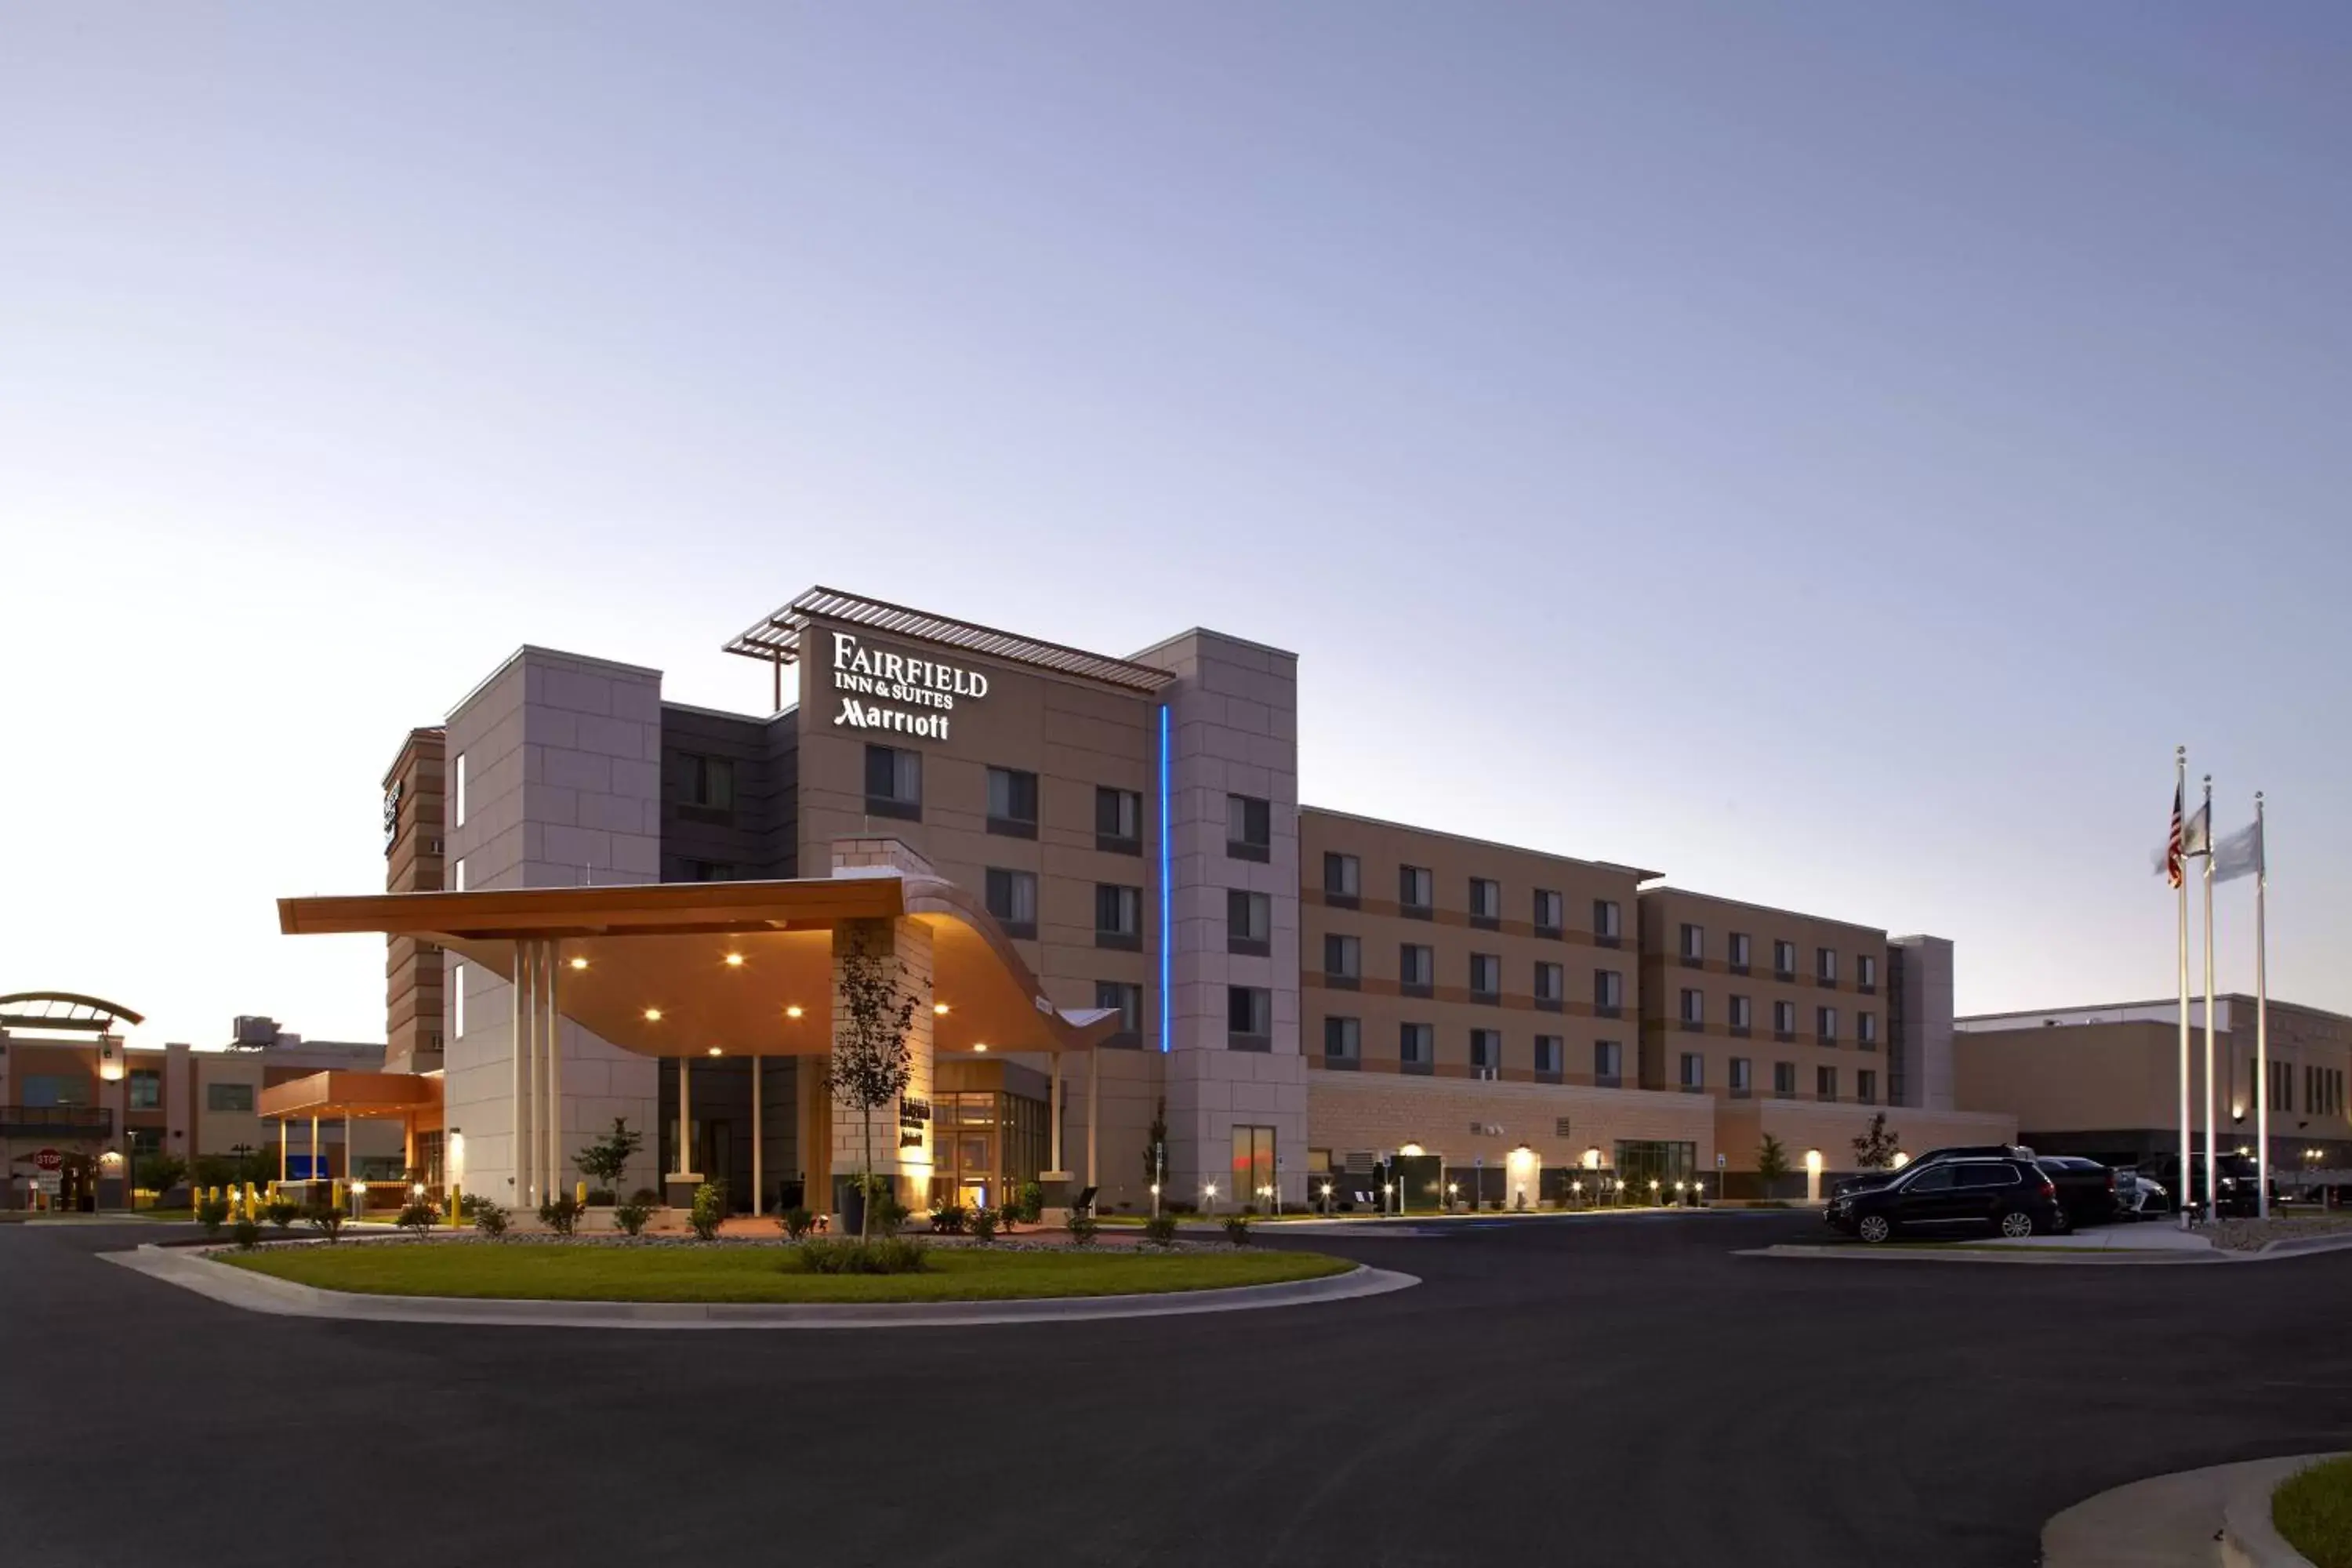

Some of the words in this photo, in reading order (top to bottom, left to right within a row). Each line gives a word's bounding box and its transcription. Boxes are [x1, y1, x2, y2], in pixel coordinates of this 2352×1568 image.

[832, 632, 989, 698] FAIRFIELD
[834, 672, 873, 694] INN
[875, 681, 890, 697] &
[892, 684, 953, 710] SUITES
[833, 697, 949, 740] Marriott
[37, 1154, 62, 1164] STOP
